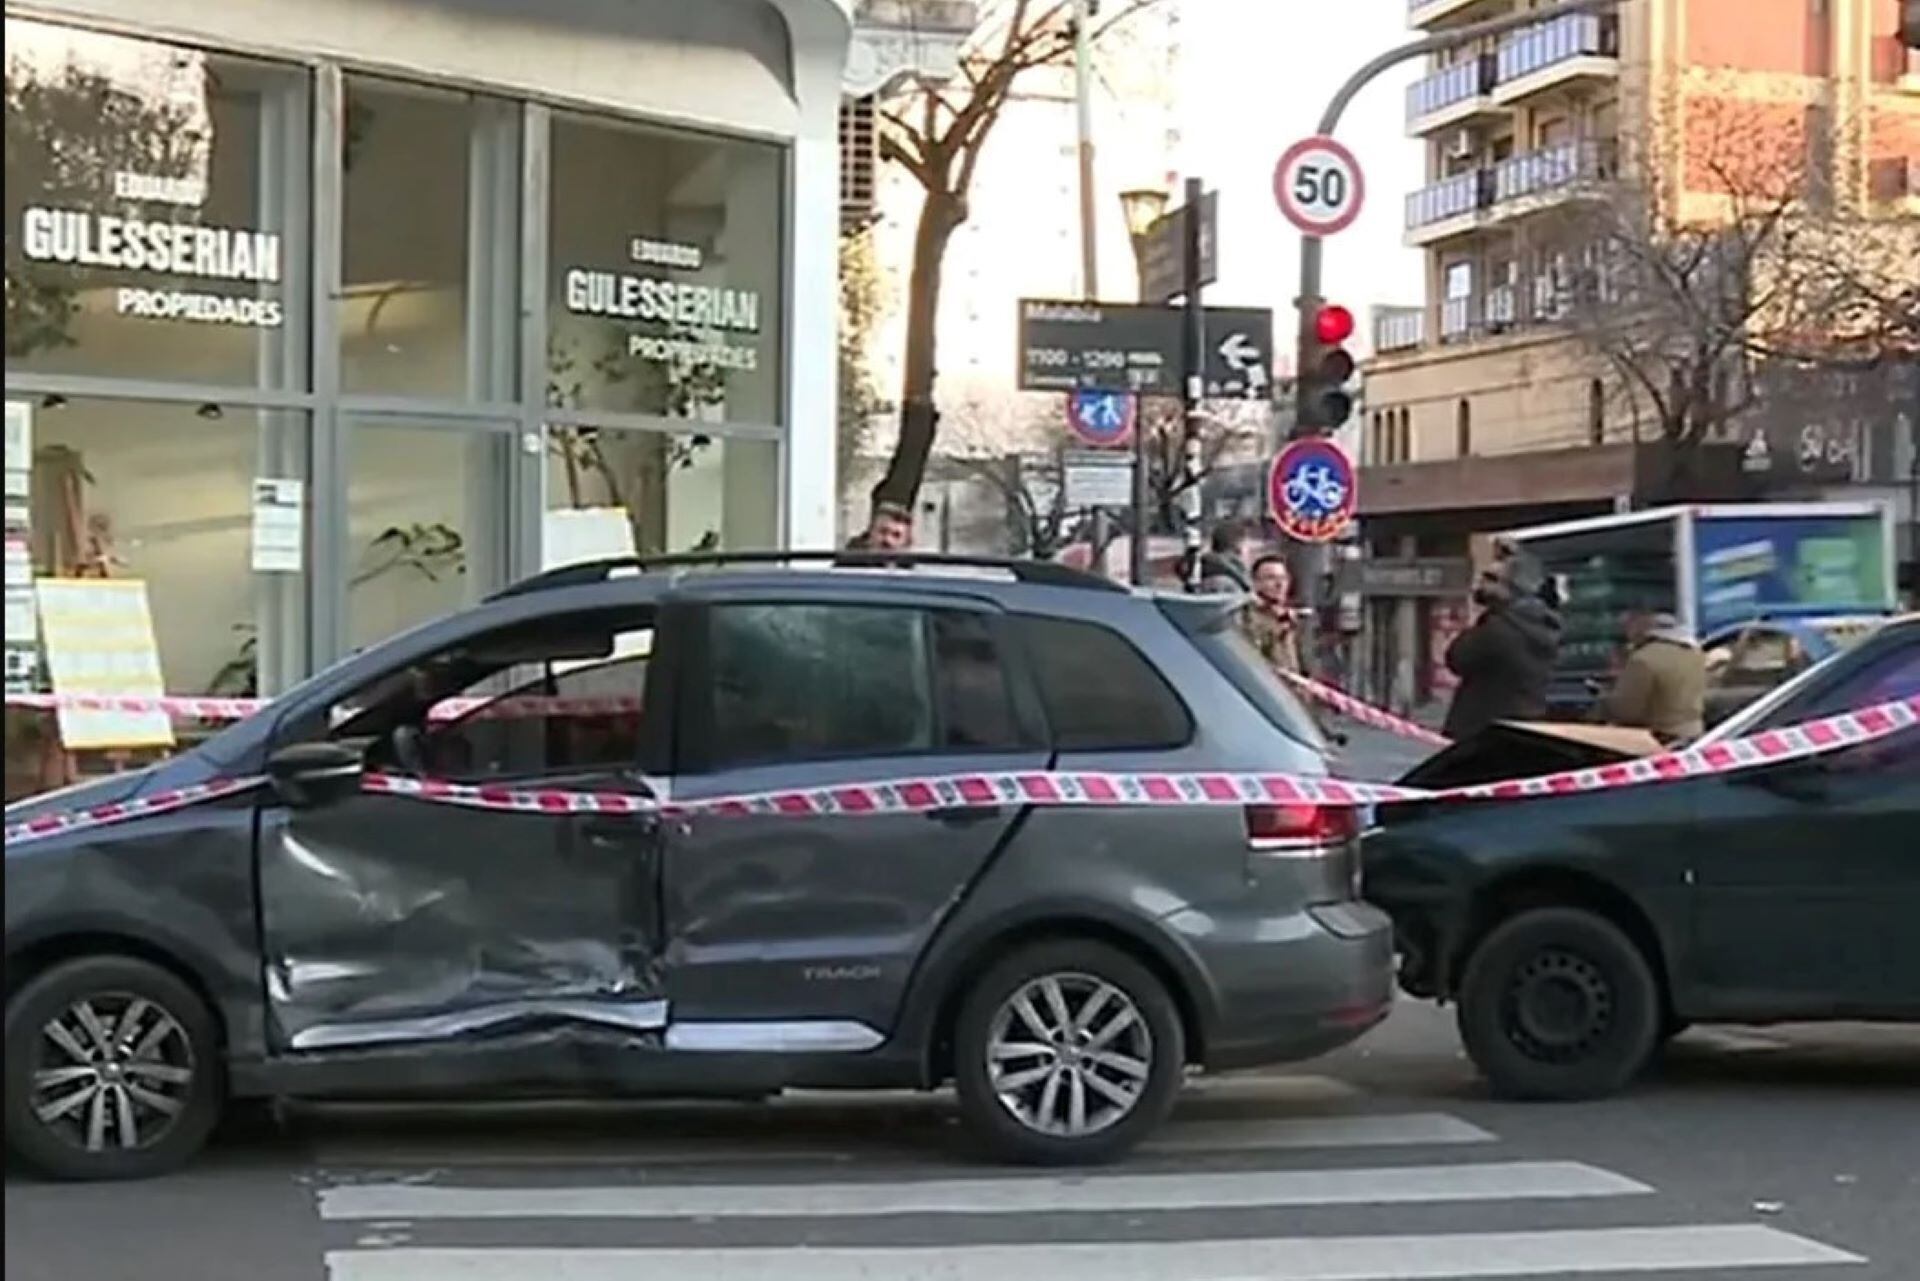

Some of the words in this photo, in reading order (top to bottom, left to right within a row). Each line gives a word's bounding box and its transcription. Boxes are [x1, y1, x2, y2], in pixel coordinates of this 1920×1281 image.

[1294, 165, 1344, 208] 50
[24, 207, 279, 281] GULESSERIAN
[117, 287, 283, 326] PROPIEDADES
[567, 269, 759, 330] GULESSERIAN
